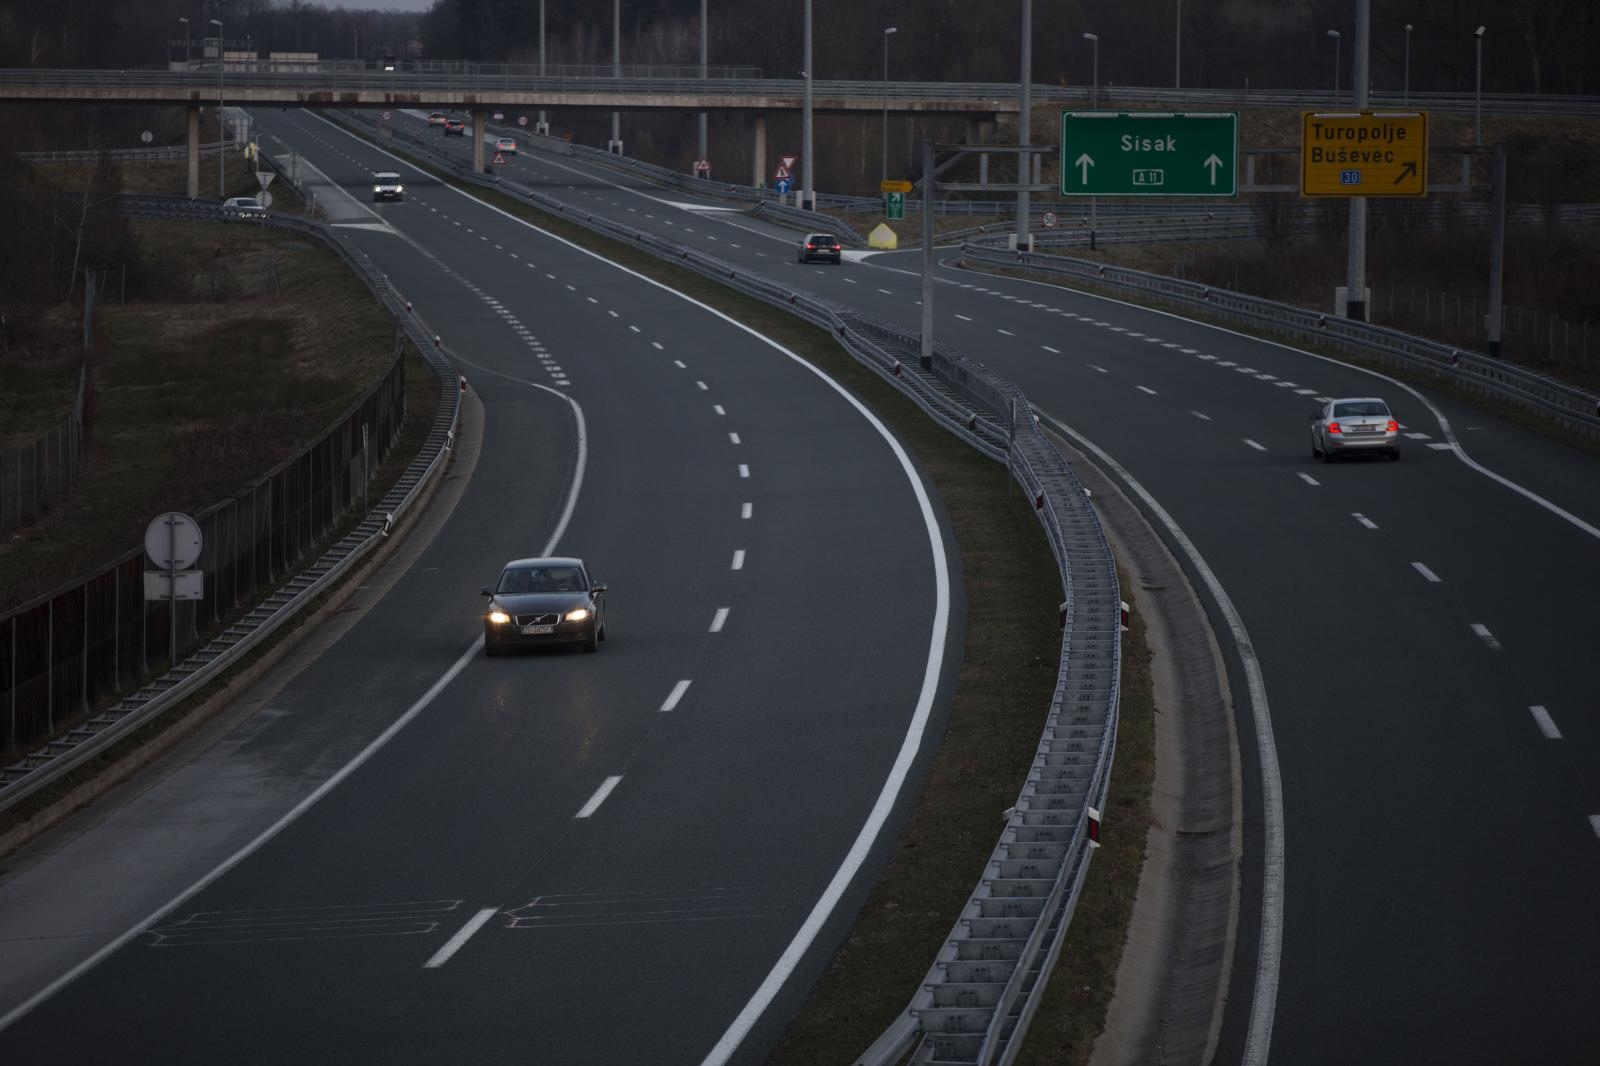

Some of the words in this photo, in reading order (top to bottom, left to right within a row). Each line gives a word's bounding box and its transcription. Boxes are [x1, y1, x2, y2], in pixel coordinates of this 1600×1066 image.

[1312, 123, 1406, 144] Turopolje
[1121, 133, 1177, 152] Sisak
[1312, 146, 1395, 163] Buševec
[1138, 172, 1145, 182] A
[1149, 171, 1157, 182] 11
[1343, 171, 1358, 183] 30
